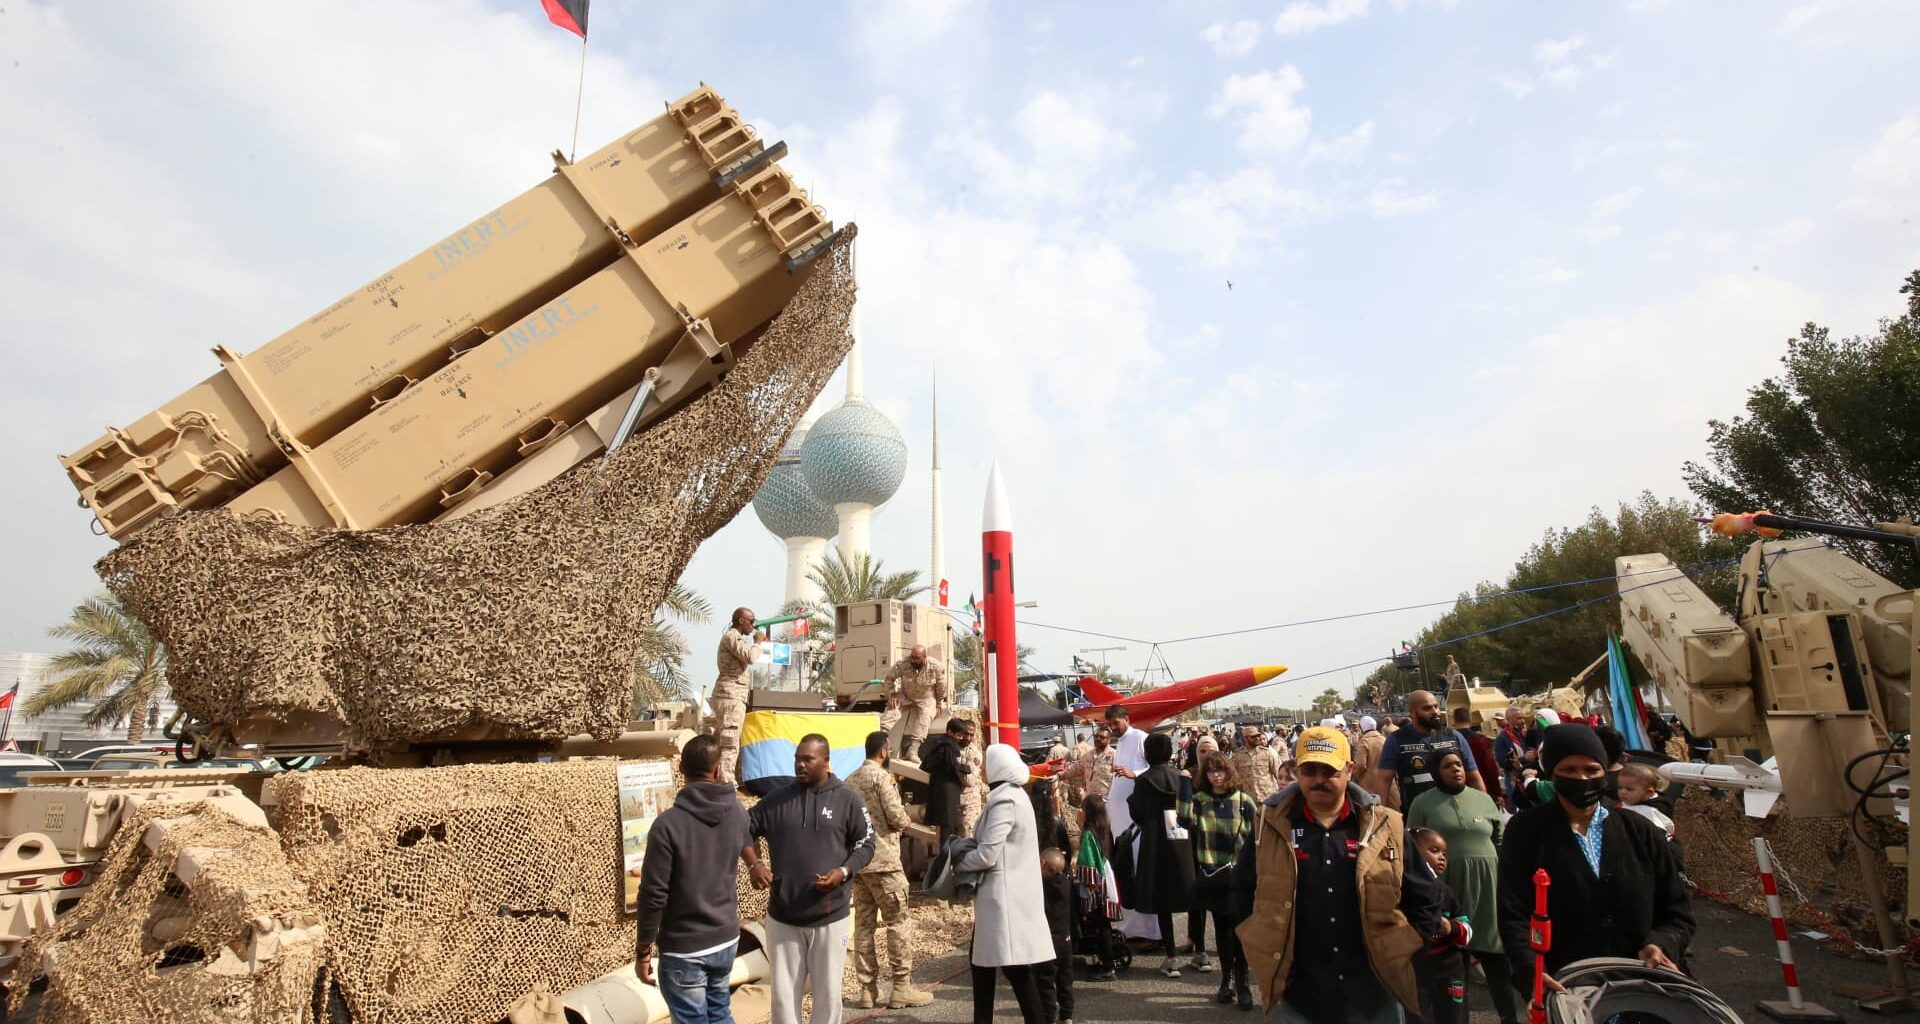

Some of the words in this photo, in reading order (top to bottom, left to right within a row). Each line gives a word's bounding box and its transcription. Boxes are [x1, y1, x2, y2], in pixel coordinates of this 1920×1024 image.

[432, 209, 508, 266] INERT
[499, 295, 575, 353] INERT
[434, 363, 460, 384] CENTER
[440, 373, 472, 397] BALANCE
